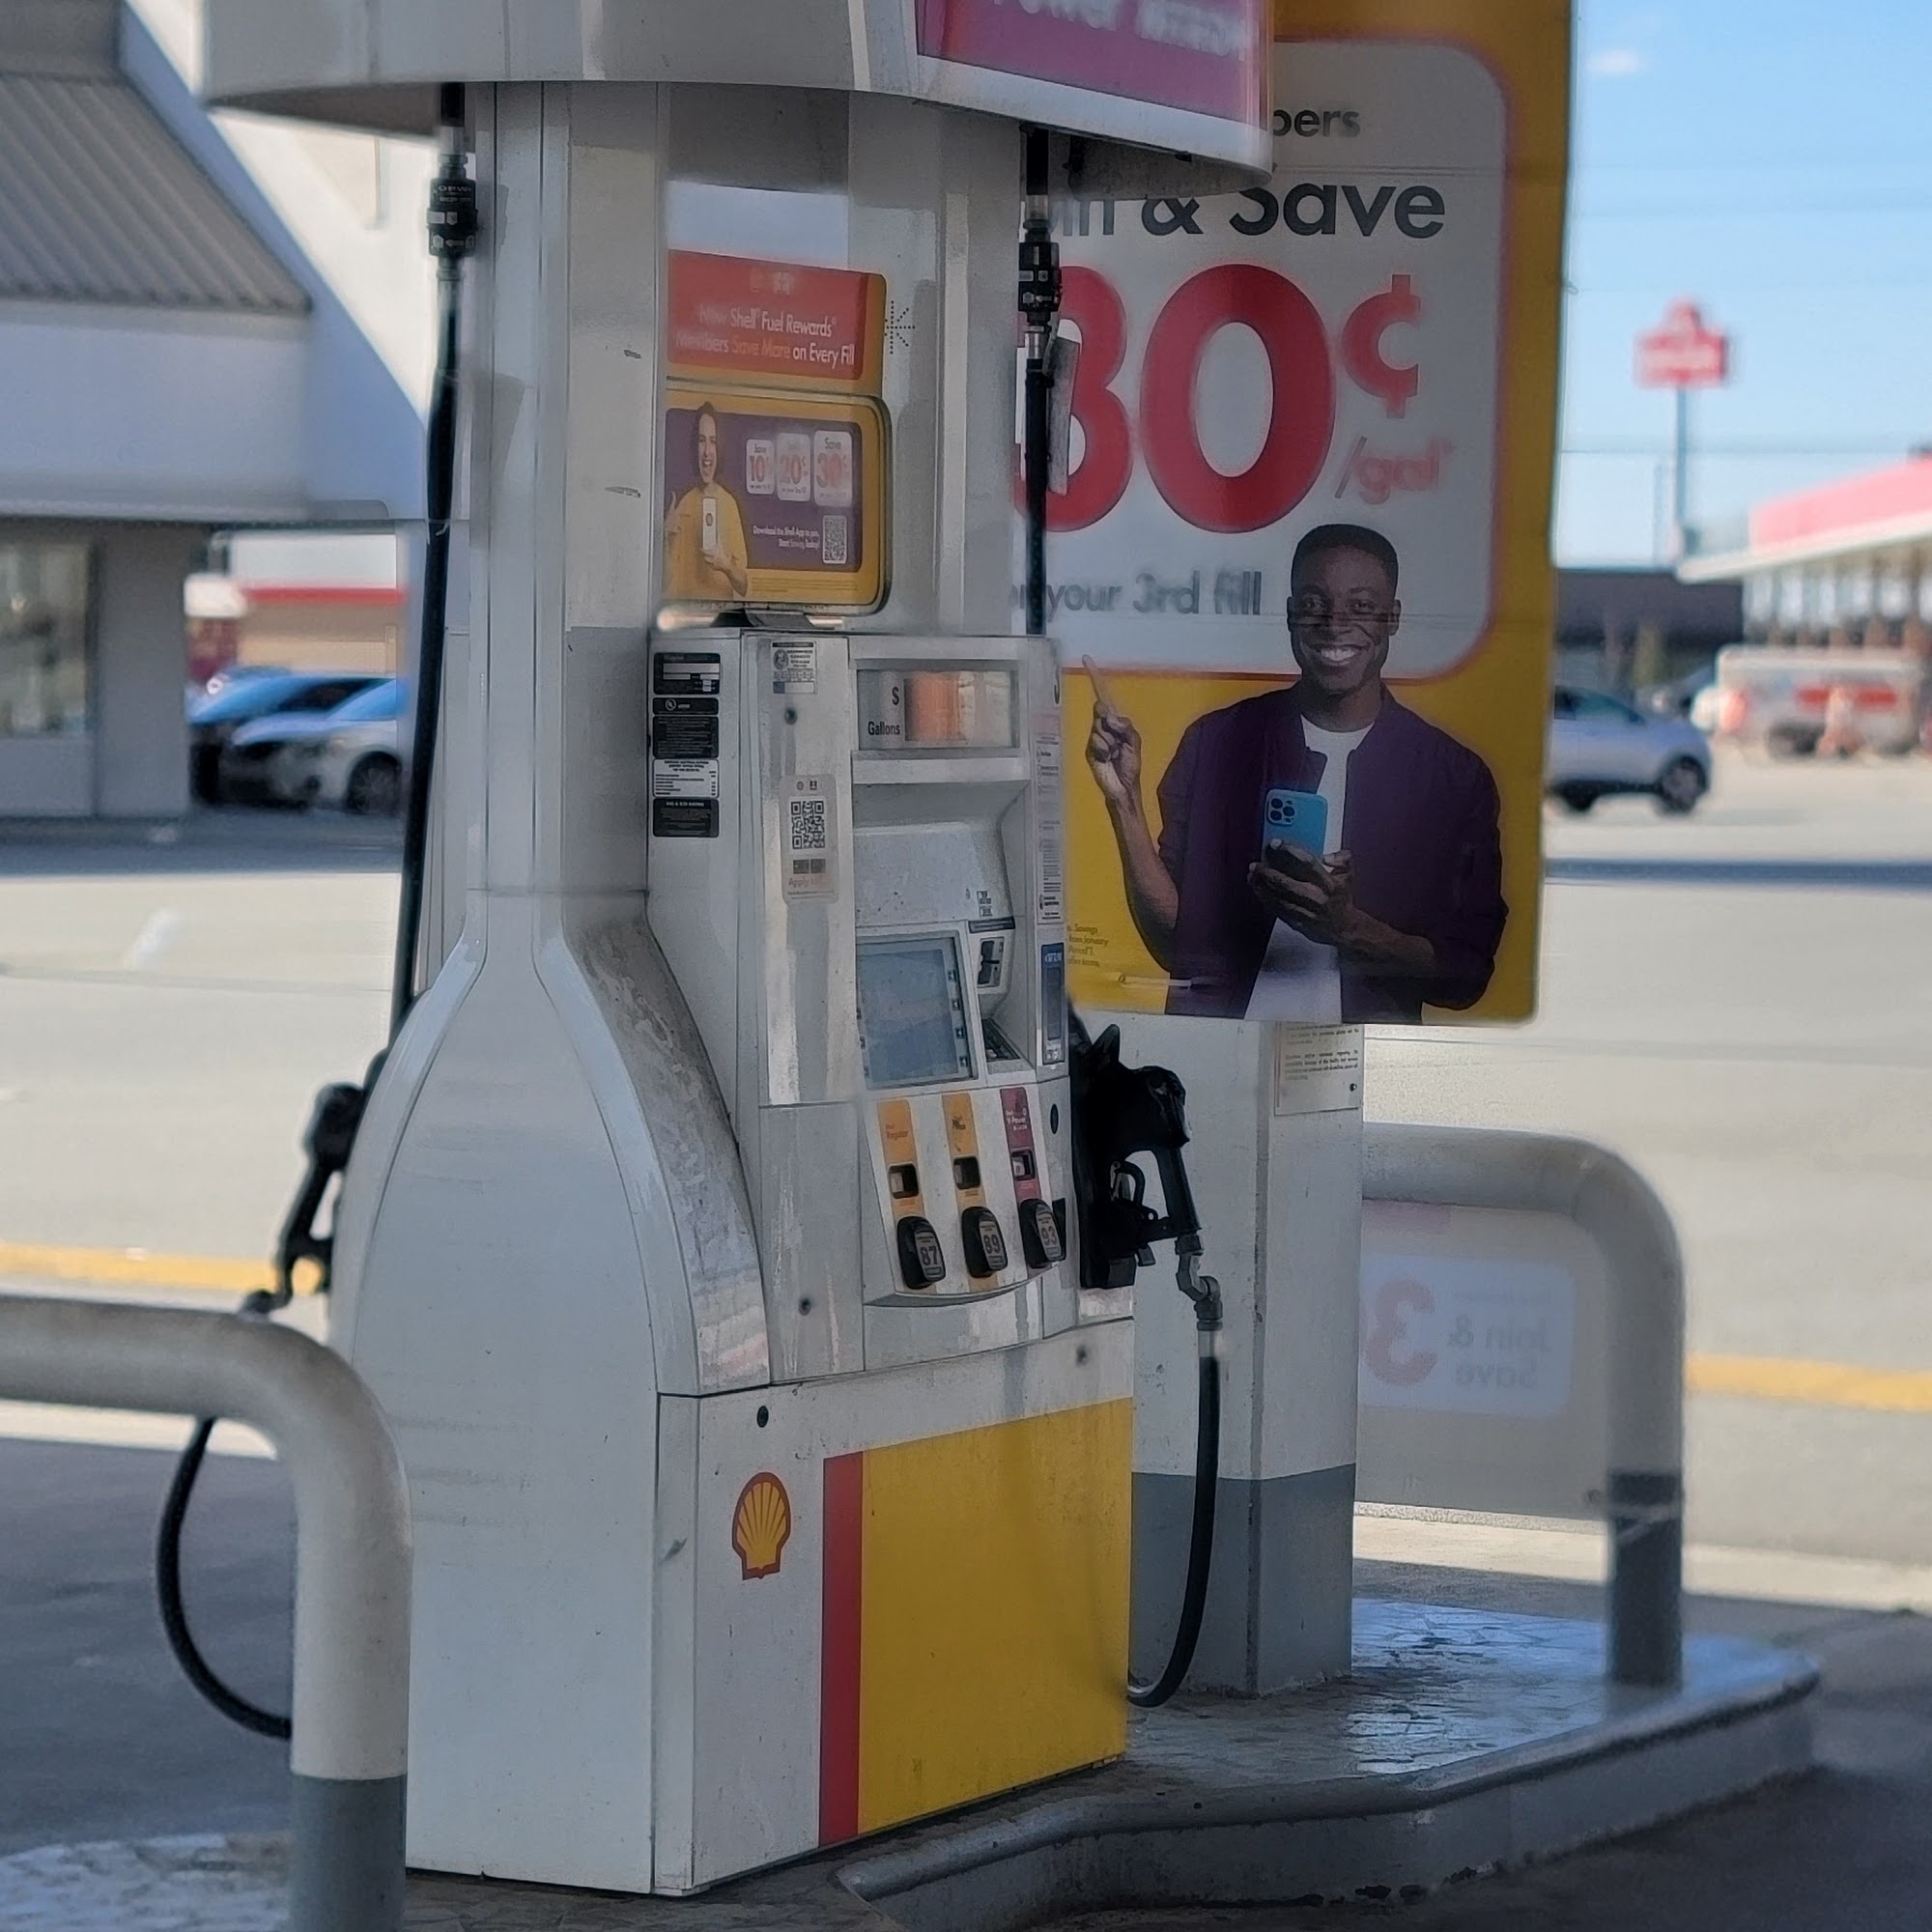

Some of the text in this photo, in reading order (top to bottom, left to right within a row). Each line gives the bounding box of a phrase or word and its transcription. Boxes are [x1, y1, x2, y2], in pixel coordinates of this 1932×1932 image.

[1229, 183, 1446, 240] Save
[761, 310, 783, 333] Fuel
[761, 337, 791, 359] More
[793, 346, 808, 360] on
[810, 342, 838, 369] Every
[840, 343, 855, 366] Fill
[1048, 583, 1122, 622] your
[1133, 572, 1200, 614] 3rd
[1214, 570, 1263, 616] fill
[867, 722, 900, 736] Gallons
[983, 1234, 1002, 1255] 89
[1040, 1225, 1059, 1246] 93
[919, 1244, 939, 1266] 87
